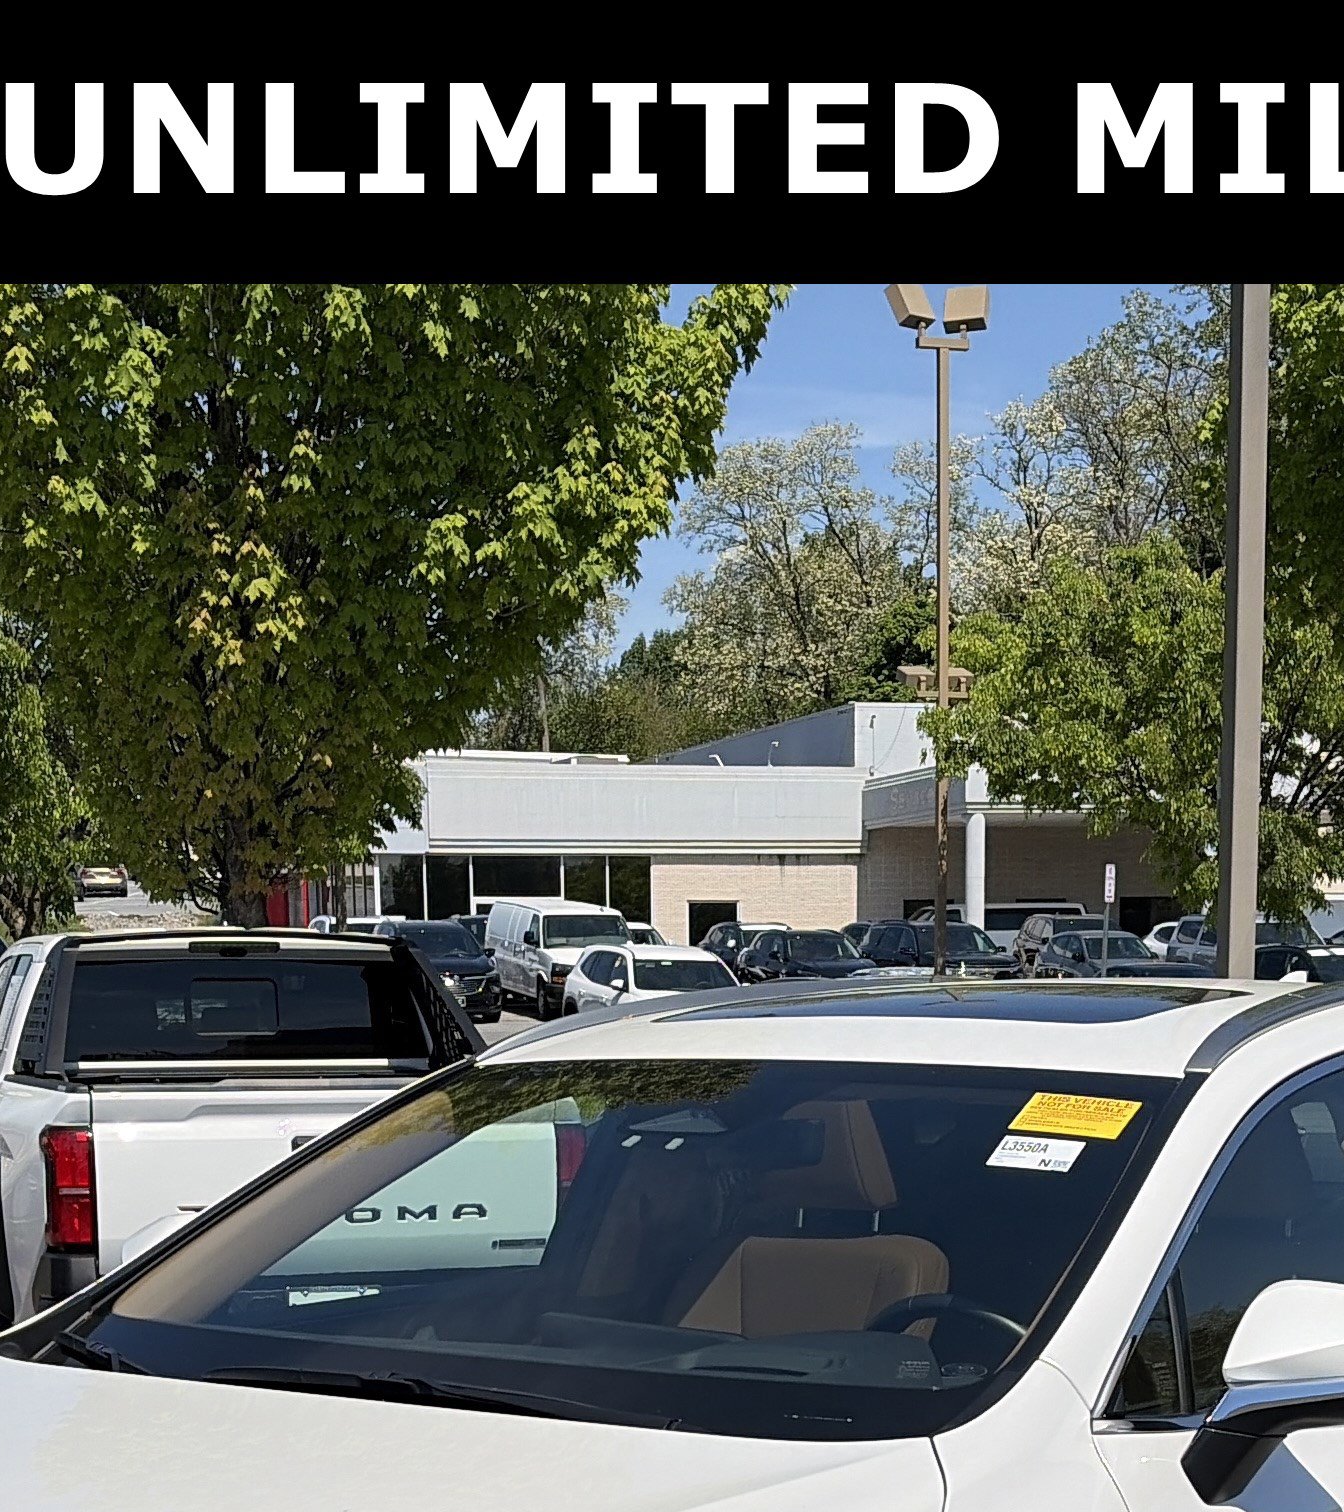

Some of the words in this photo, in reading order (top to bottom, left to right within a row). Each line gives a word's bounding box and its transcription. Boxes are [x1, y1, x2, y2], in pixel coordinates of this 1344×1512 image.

[1039, 1094, 1070, 1103] THIS
[1074, 1098, 1133, 1110] VEHICLE
[1065, 1102, 1093, 1111] FOR
[1093, 1105, 1126, 1114] SALE
